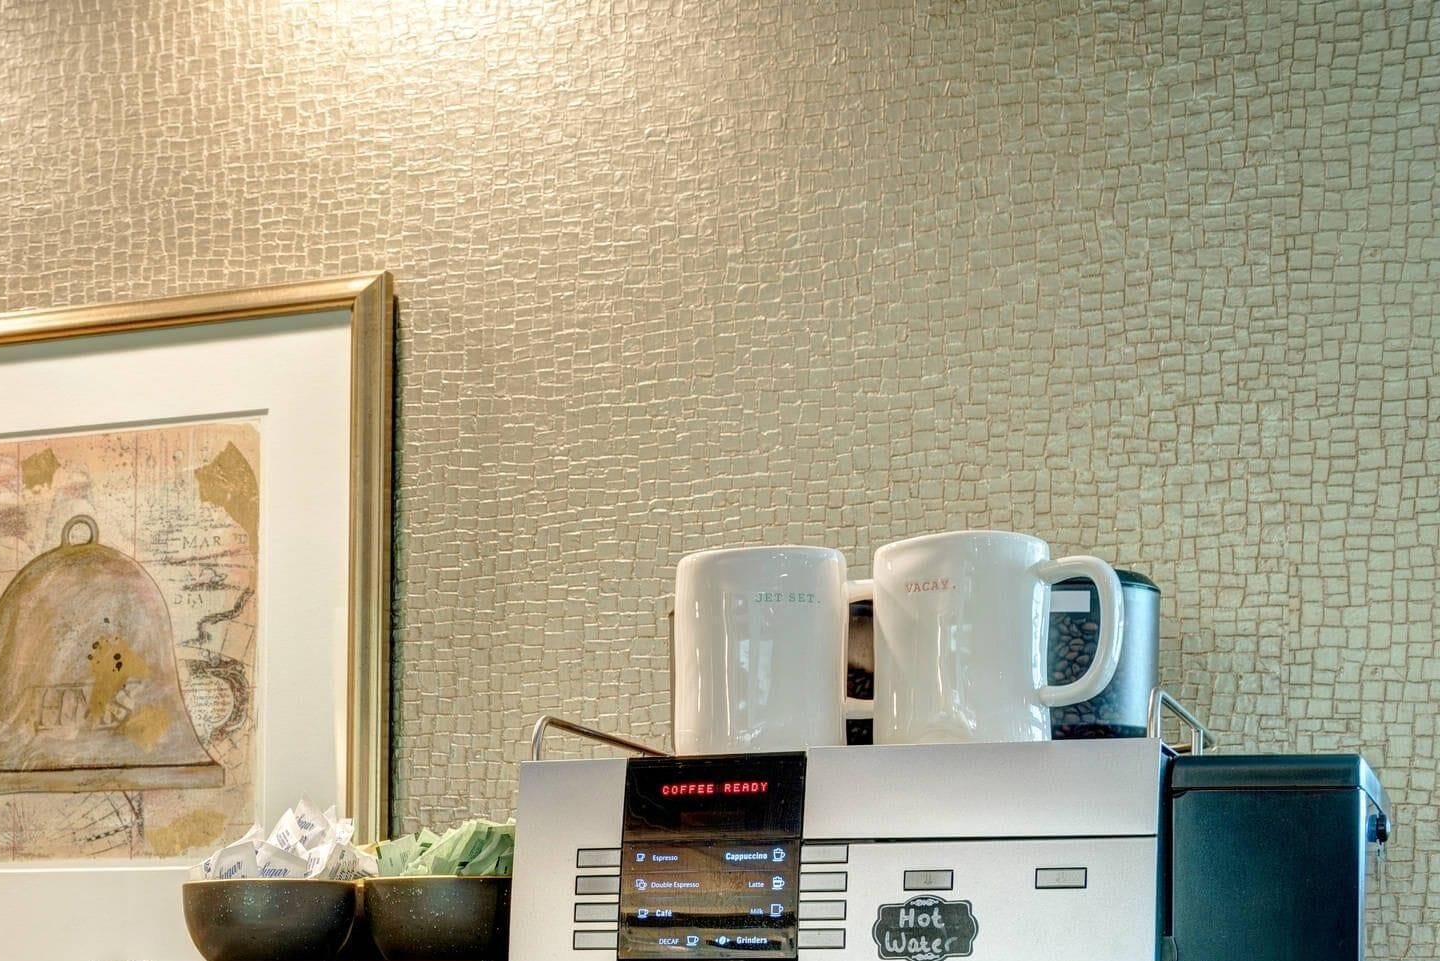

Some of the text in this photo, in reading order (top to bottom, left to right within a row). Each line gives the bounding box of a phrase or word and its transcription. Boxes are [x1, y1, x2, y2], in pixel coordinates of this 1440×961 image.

[905, 579, 957, 593] VACAY.
[755, 592, 822, 604] JET SET.
[662, 782, 768, 795] COFFEE READY
[652, 854, 679, 862] Espresso
[725, 852, 768, 862] Cappuccino
[260, 862, 290, 879] Sugar
[650, 881, 700, 890] Double Espresso
[655, 909, 673, 918] Café
[898, 907, 945, 929] Hot
[736, 936, 768, 945] Grinders
[884, 930, 959, 953] Water
